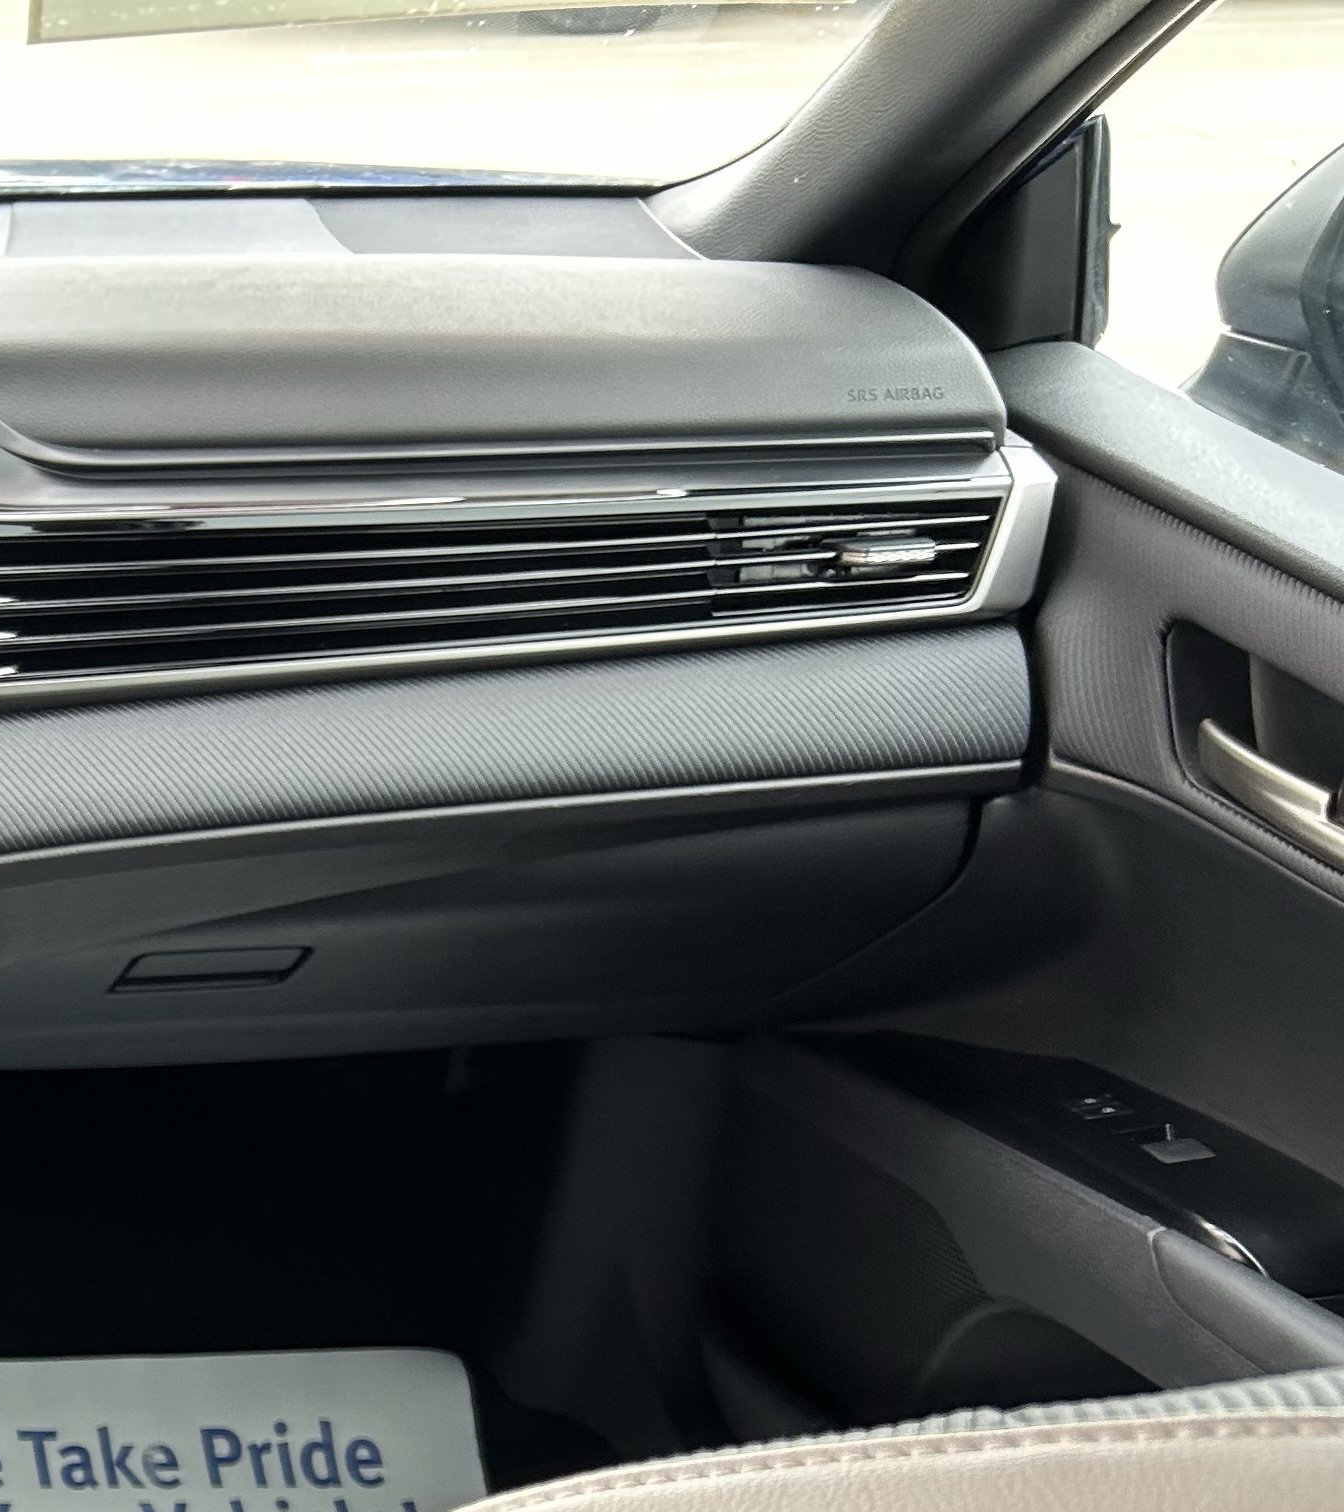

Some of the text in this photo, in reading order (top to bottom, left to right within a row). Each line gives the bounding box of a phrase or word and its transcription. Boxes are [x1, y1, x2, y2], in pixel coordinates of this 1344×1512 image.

[847, 387, 944, 401] SRS AIRBAG
[15, 1425, 182, 1490] Take
[199, 1417, 385, 1489] Pride
